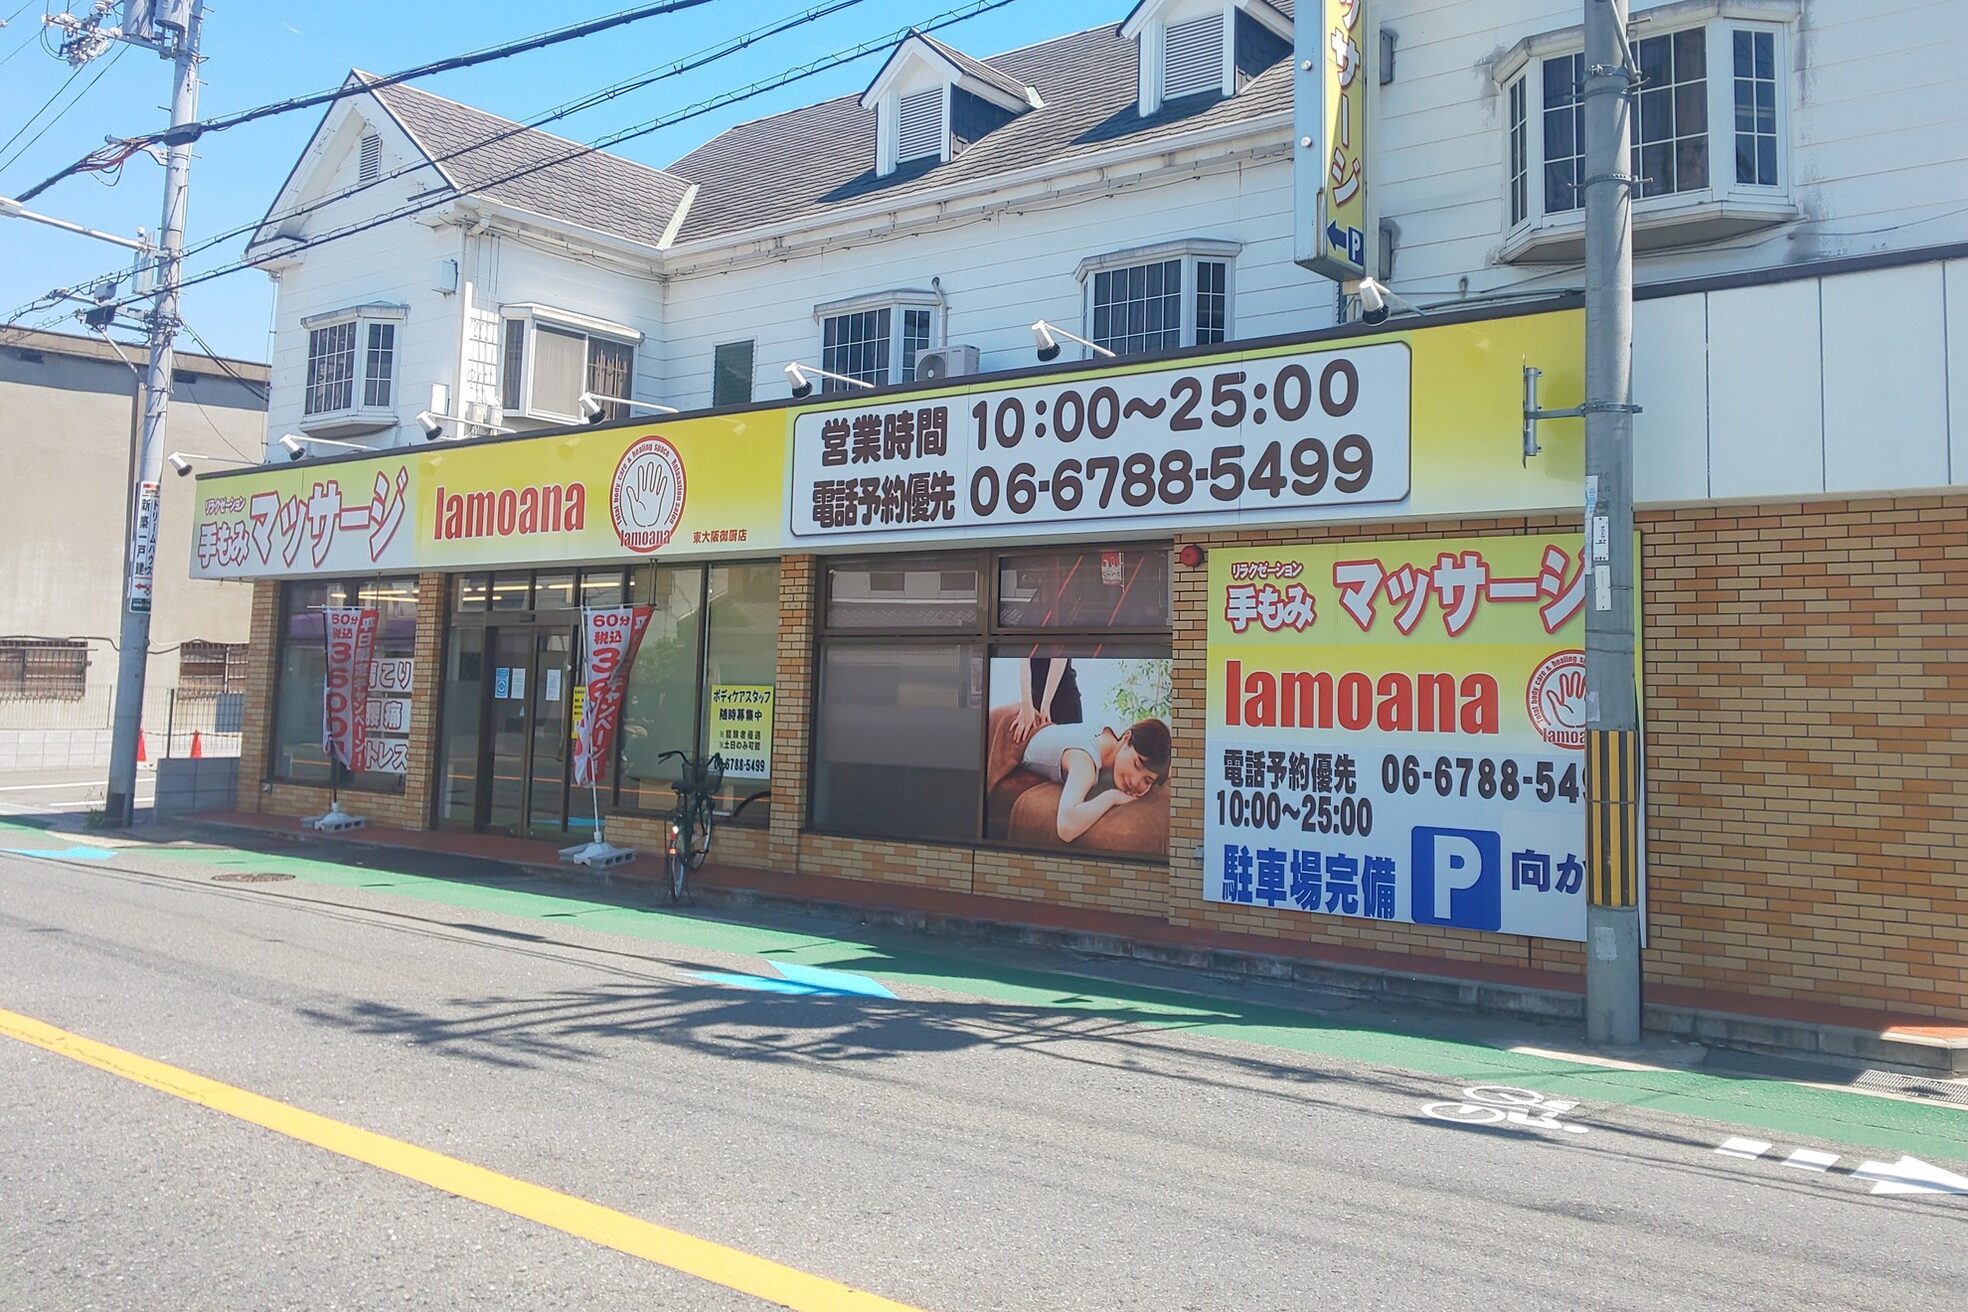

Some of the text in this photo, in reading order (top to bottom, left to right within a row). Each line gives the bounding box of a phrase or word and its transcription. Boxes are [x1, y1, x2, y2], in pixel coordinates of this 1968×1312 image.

[820, 406, 948, 467] 営業時間
[204, 496, 246, 516] リラクゼーション
[812, 434, 1374, 528] 電話予約優先 06-6788-5499
[198, 465, 408, 569] 手もみ マッサージ
[434, 483, 586, 541] lamoana
[620, 530, 671, 547] lamoana
[693, 529, 748, 544] 東大阪御厨店
[1231, 560, 1303, 579] リラクゼーション
[592, 614, 631, 627] 60分
[1225, 584, 1317, 633] 手もみ
[594, 631, 622, 645] 税込
[1225, 660, 1499, 735] lamoana
[1224, 749, 1586, 803] 電話予約優先 06-6788-54
[1222, 844, 1396, 920] 駐車場完備
[1434, 834, 1483, 920] P
